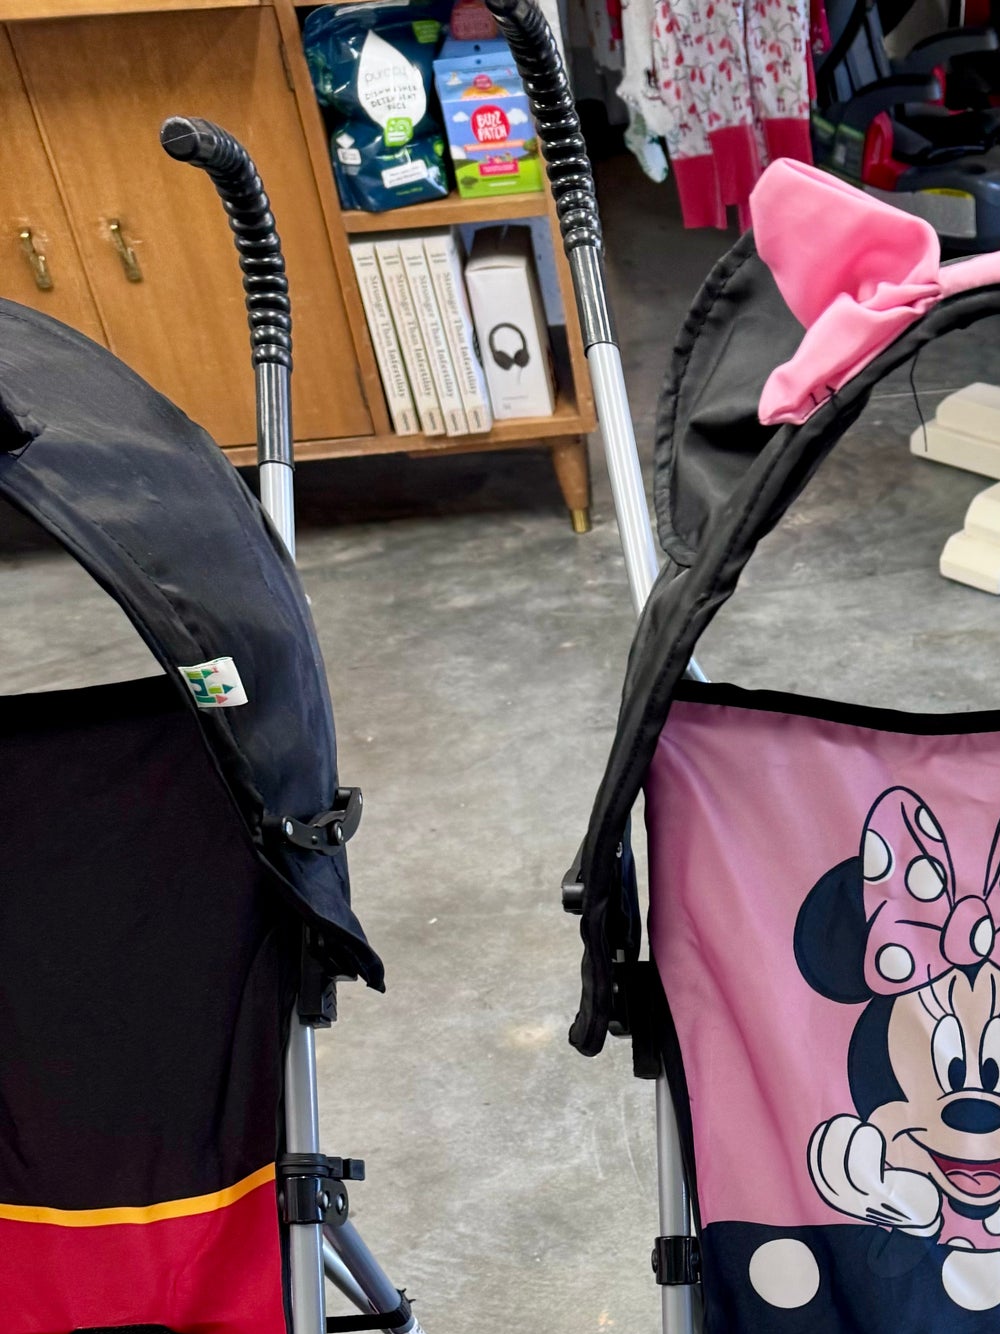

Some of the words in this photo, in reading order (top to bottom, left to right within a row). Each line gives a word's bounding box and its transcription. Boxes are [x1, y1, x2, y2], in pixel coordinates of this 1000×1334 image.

[476, 111, 502, 128] BUZZ
[477, 125, 507, 142] PATCH
[419, 275, 435, 318] Stronger
[370, 274, 387, 318] Stronger
[380, 321, 393, 347] Than
[387, 349, 405, 398] Infertility
[396, 273, 411, 320] Stronger
[406, 320, 420, 347] Than
[414, 347, 433, 397] Infertility
[430, 321, 443, 347] Than
[443, 272, 460, 315] Stronger
[453, 318, 467, 345] Than
[460, 345, 478, 395] Infertility
[436, 348, 454, 398] Infertility
